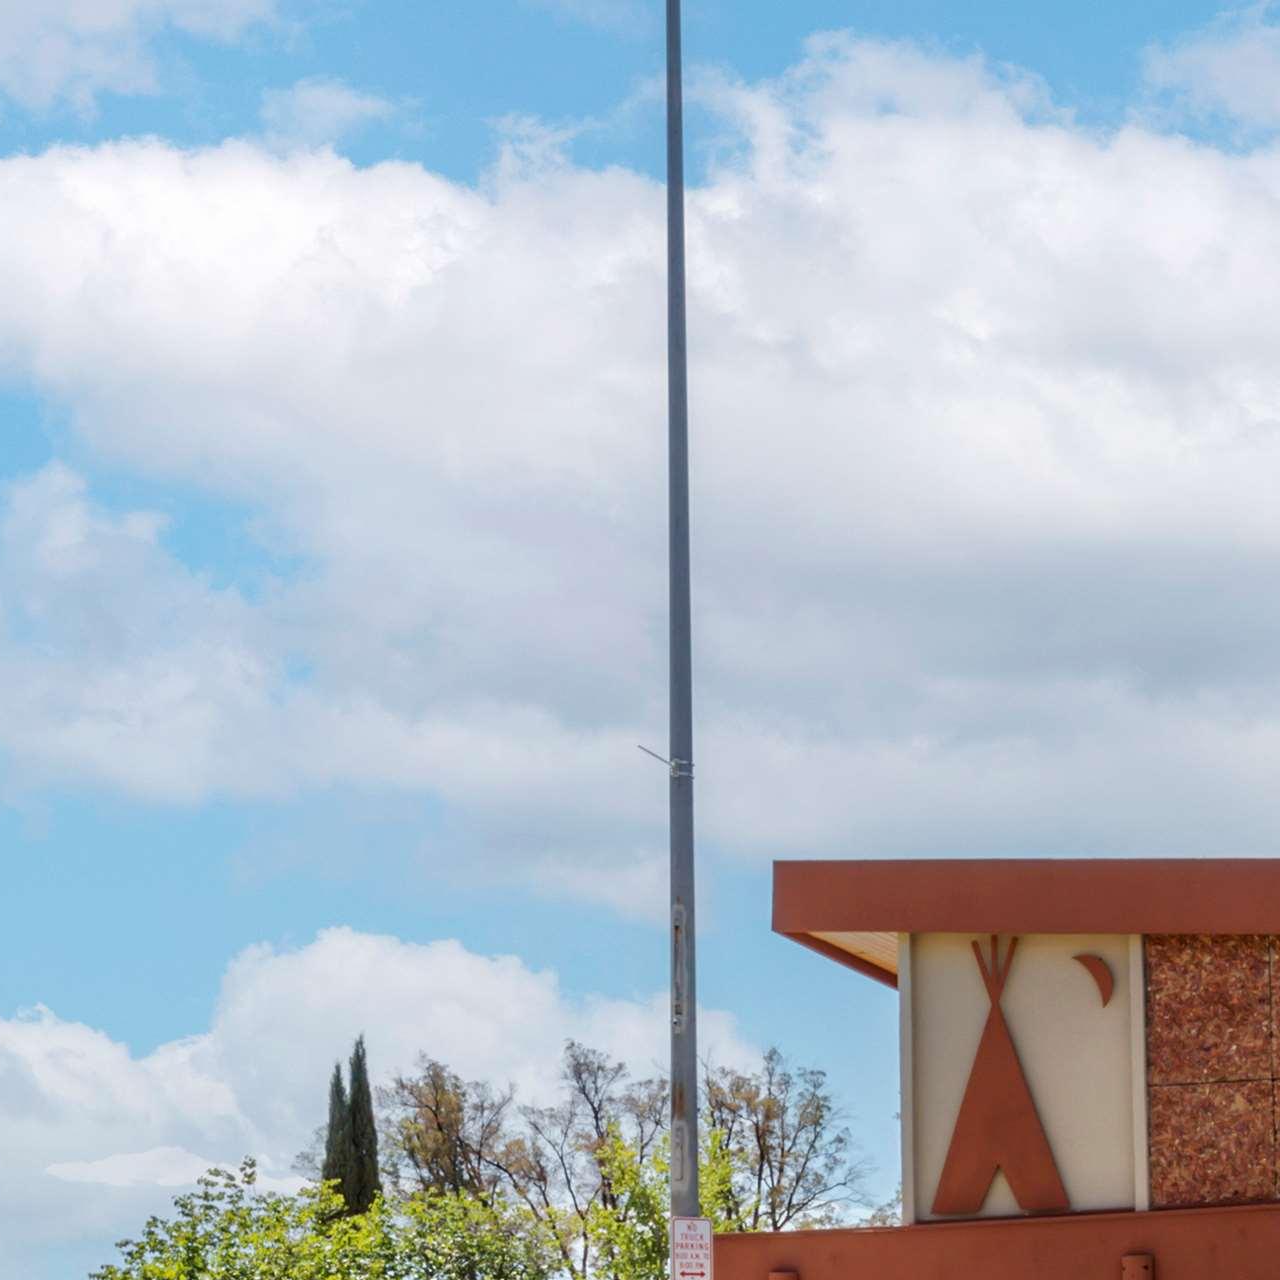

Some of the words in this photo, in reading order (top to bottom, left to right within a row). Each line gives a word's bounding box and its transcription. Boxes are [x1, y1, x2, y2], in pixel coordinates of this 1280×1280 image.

[686, 1223, 698, 1232] NO
[680, 1232, 704, 1240] TRUCK
[676, 1242, 710, 1250] PARKING
